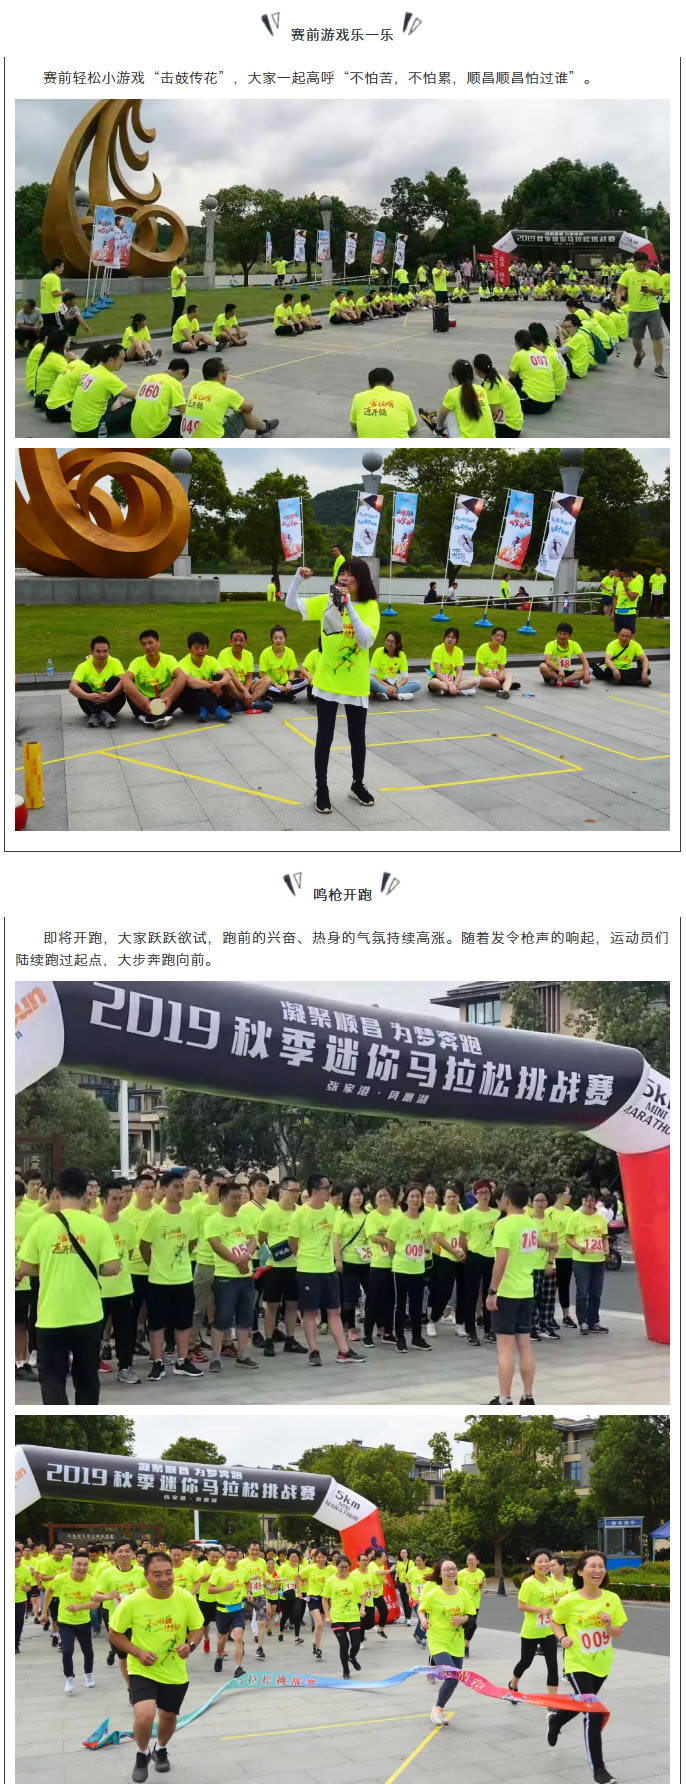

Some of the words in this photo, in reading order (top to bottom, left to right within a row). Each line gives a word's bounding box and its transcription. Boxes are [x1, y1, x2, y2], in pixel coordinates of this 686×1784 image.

[530, 355, 549, 367] 007
[139, 384, 160, 398] 060
[280, 1000, 383, 1040] 凝聚顺昌
[390, 1021, 483, 1056] 为梦奔跑
[642, 1078, 671, 1109] 5k
[645, 1102, 669, 1120] MINI
[335, 1489, 361, 1510] 5km
